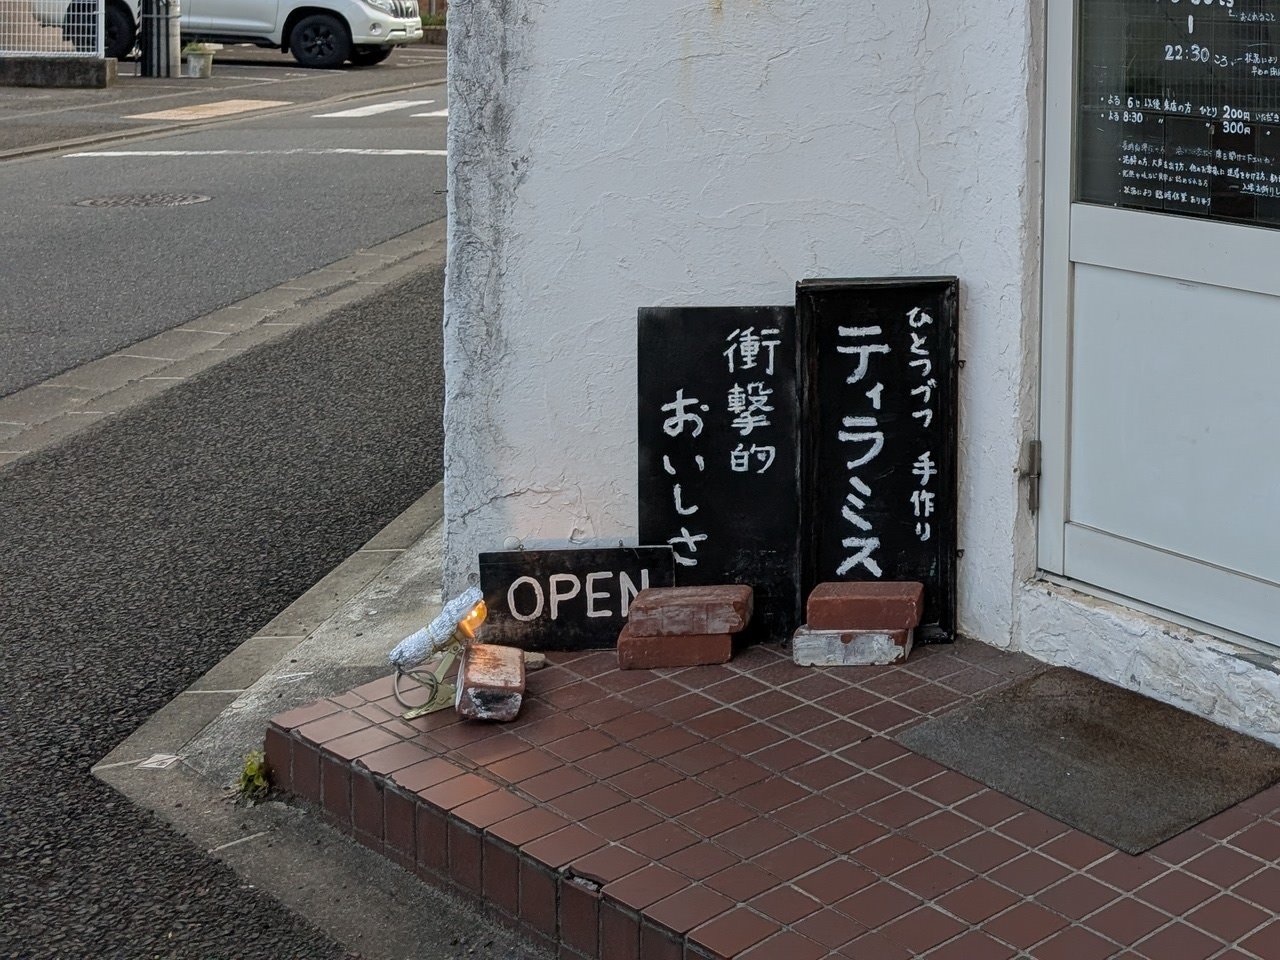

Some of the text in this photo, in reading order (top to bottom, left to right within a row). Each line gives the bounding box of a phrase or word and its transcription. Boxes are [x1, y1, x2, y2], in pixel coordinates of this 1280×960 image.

[1165, 44, 1210, 63] 22:30
[1123, 111, 1144, 124] 8:30
[1222, 105, 1251, 120] 200円
[723, 326, 781, 474] 衝撃的
[660, 388, 710, 568] おいしさ
[835, 324, 890, 578] ティラミス
[910, 452, 938, 542] 手作り
[507, 568, 650, 621] OPEN
